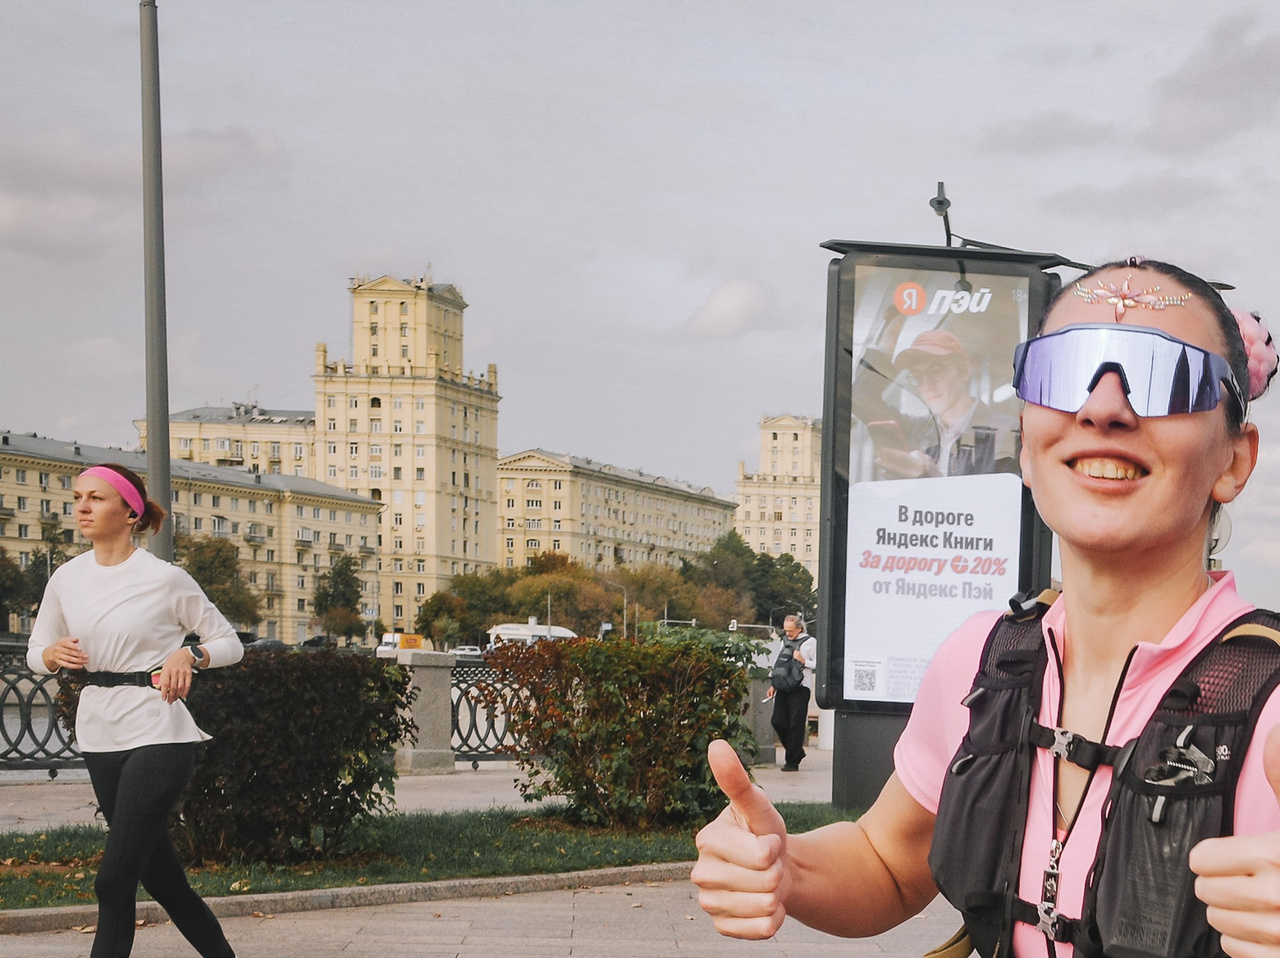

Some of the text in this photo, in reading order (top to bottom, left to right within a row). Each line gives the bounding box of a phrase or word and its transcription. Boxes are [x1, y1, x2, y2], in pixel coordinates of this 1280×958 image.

[902, 288, 917, 310] Я
[898, 505, 974, 528] В дороге
[876, 528, 994, 551] Яндекс Книги
[859, 550, 1008, 576] За дорогу 20%
[872, 578, 993, 600] от Яндекс Пэй
